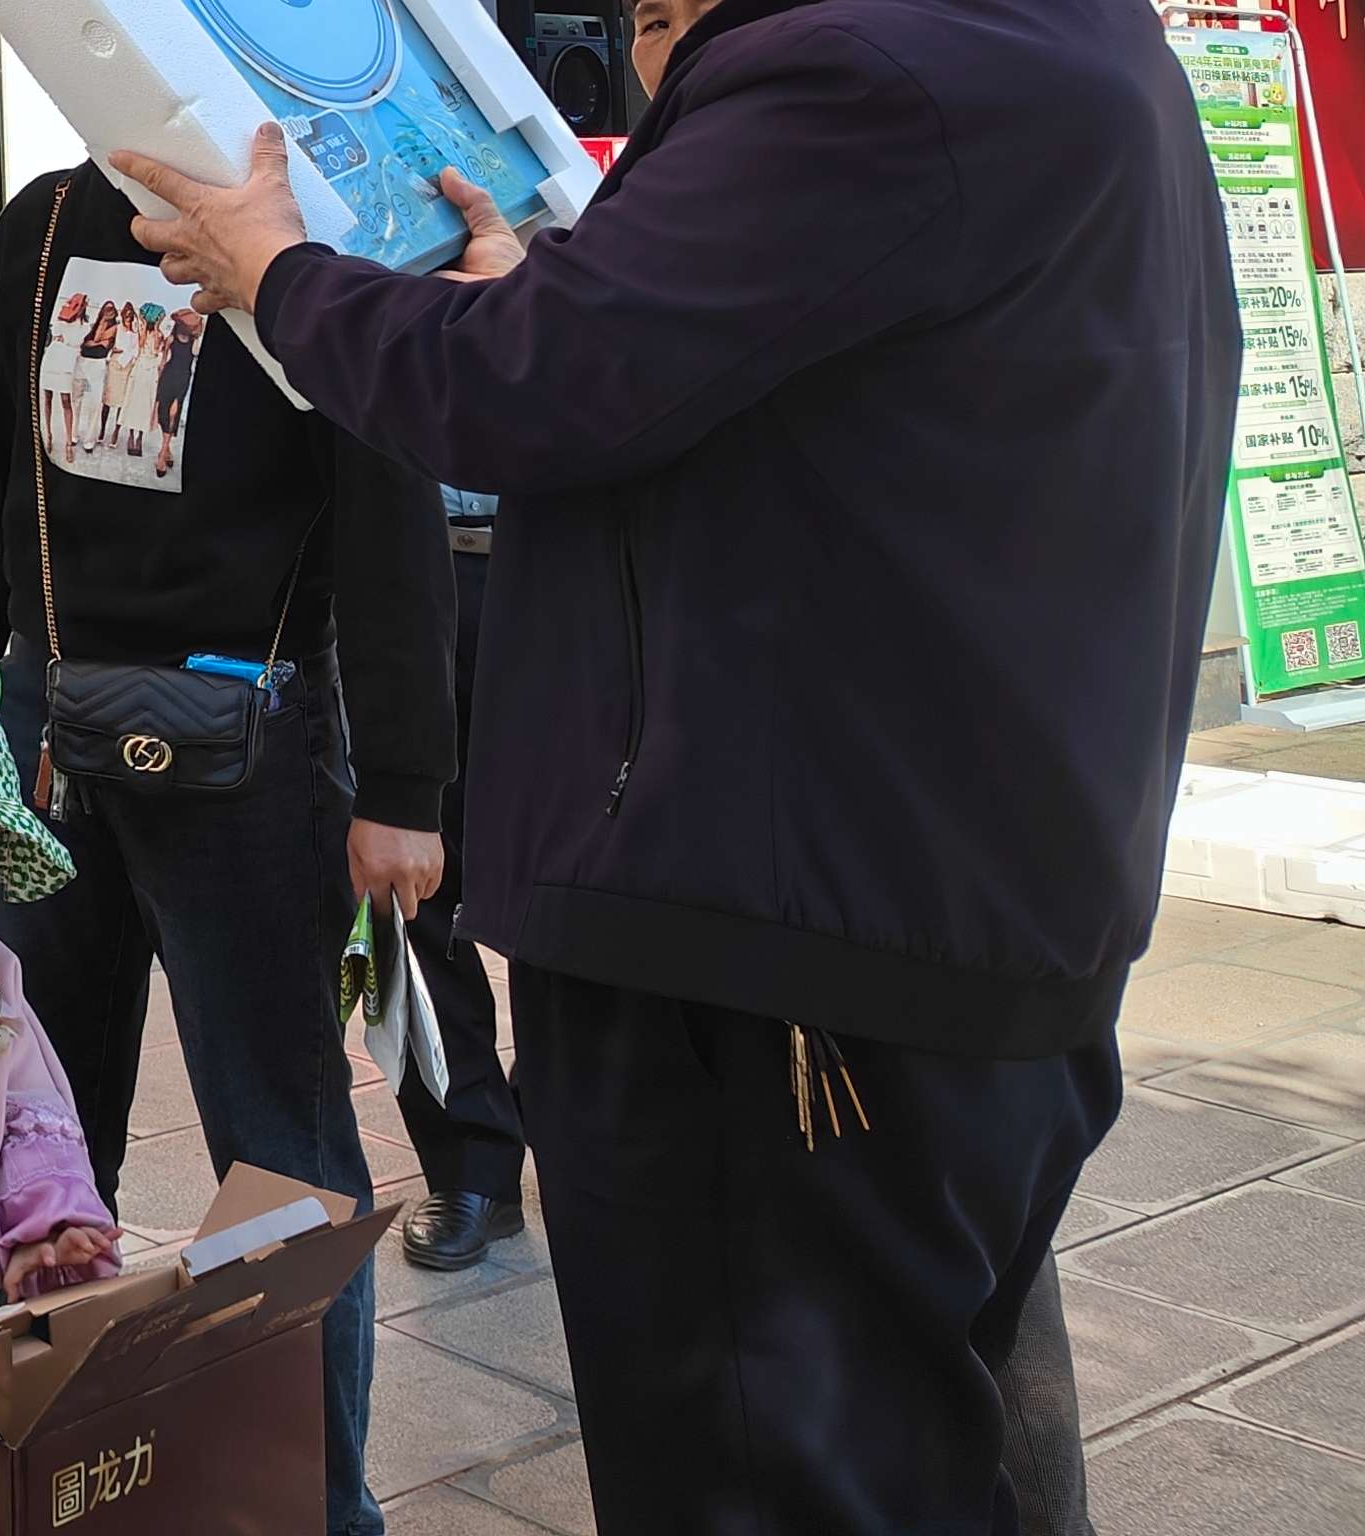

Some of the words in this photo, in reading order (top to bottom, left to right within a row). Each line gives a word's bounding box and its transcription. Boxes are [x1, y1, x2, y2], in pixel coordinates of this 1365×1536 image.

[1269, 286, 1301, 308] 20%
[1279, 326, 1307, 348] 15%
[1289, 375, 1318, 398] 15%
[1245, 432, 1294, 448] 国家补贴
[1297, 424, 1329, 448] 10%
